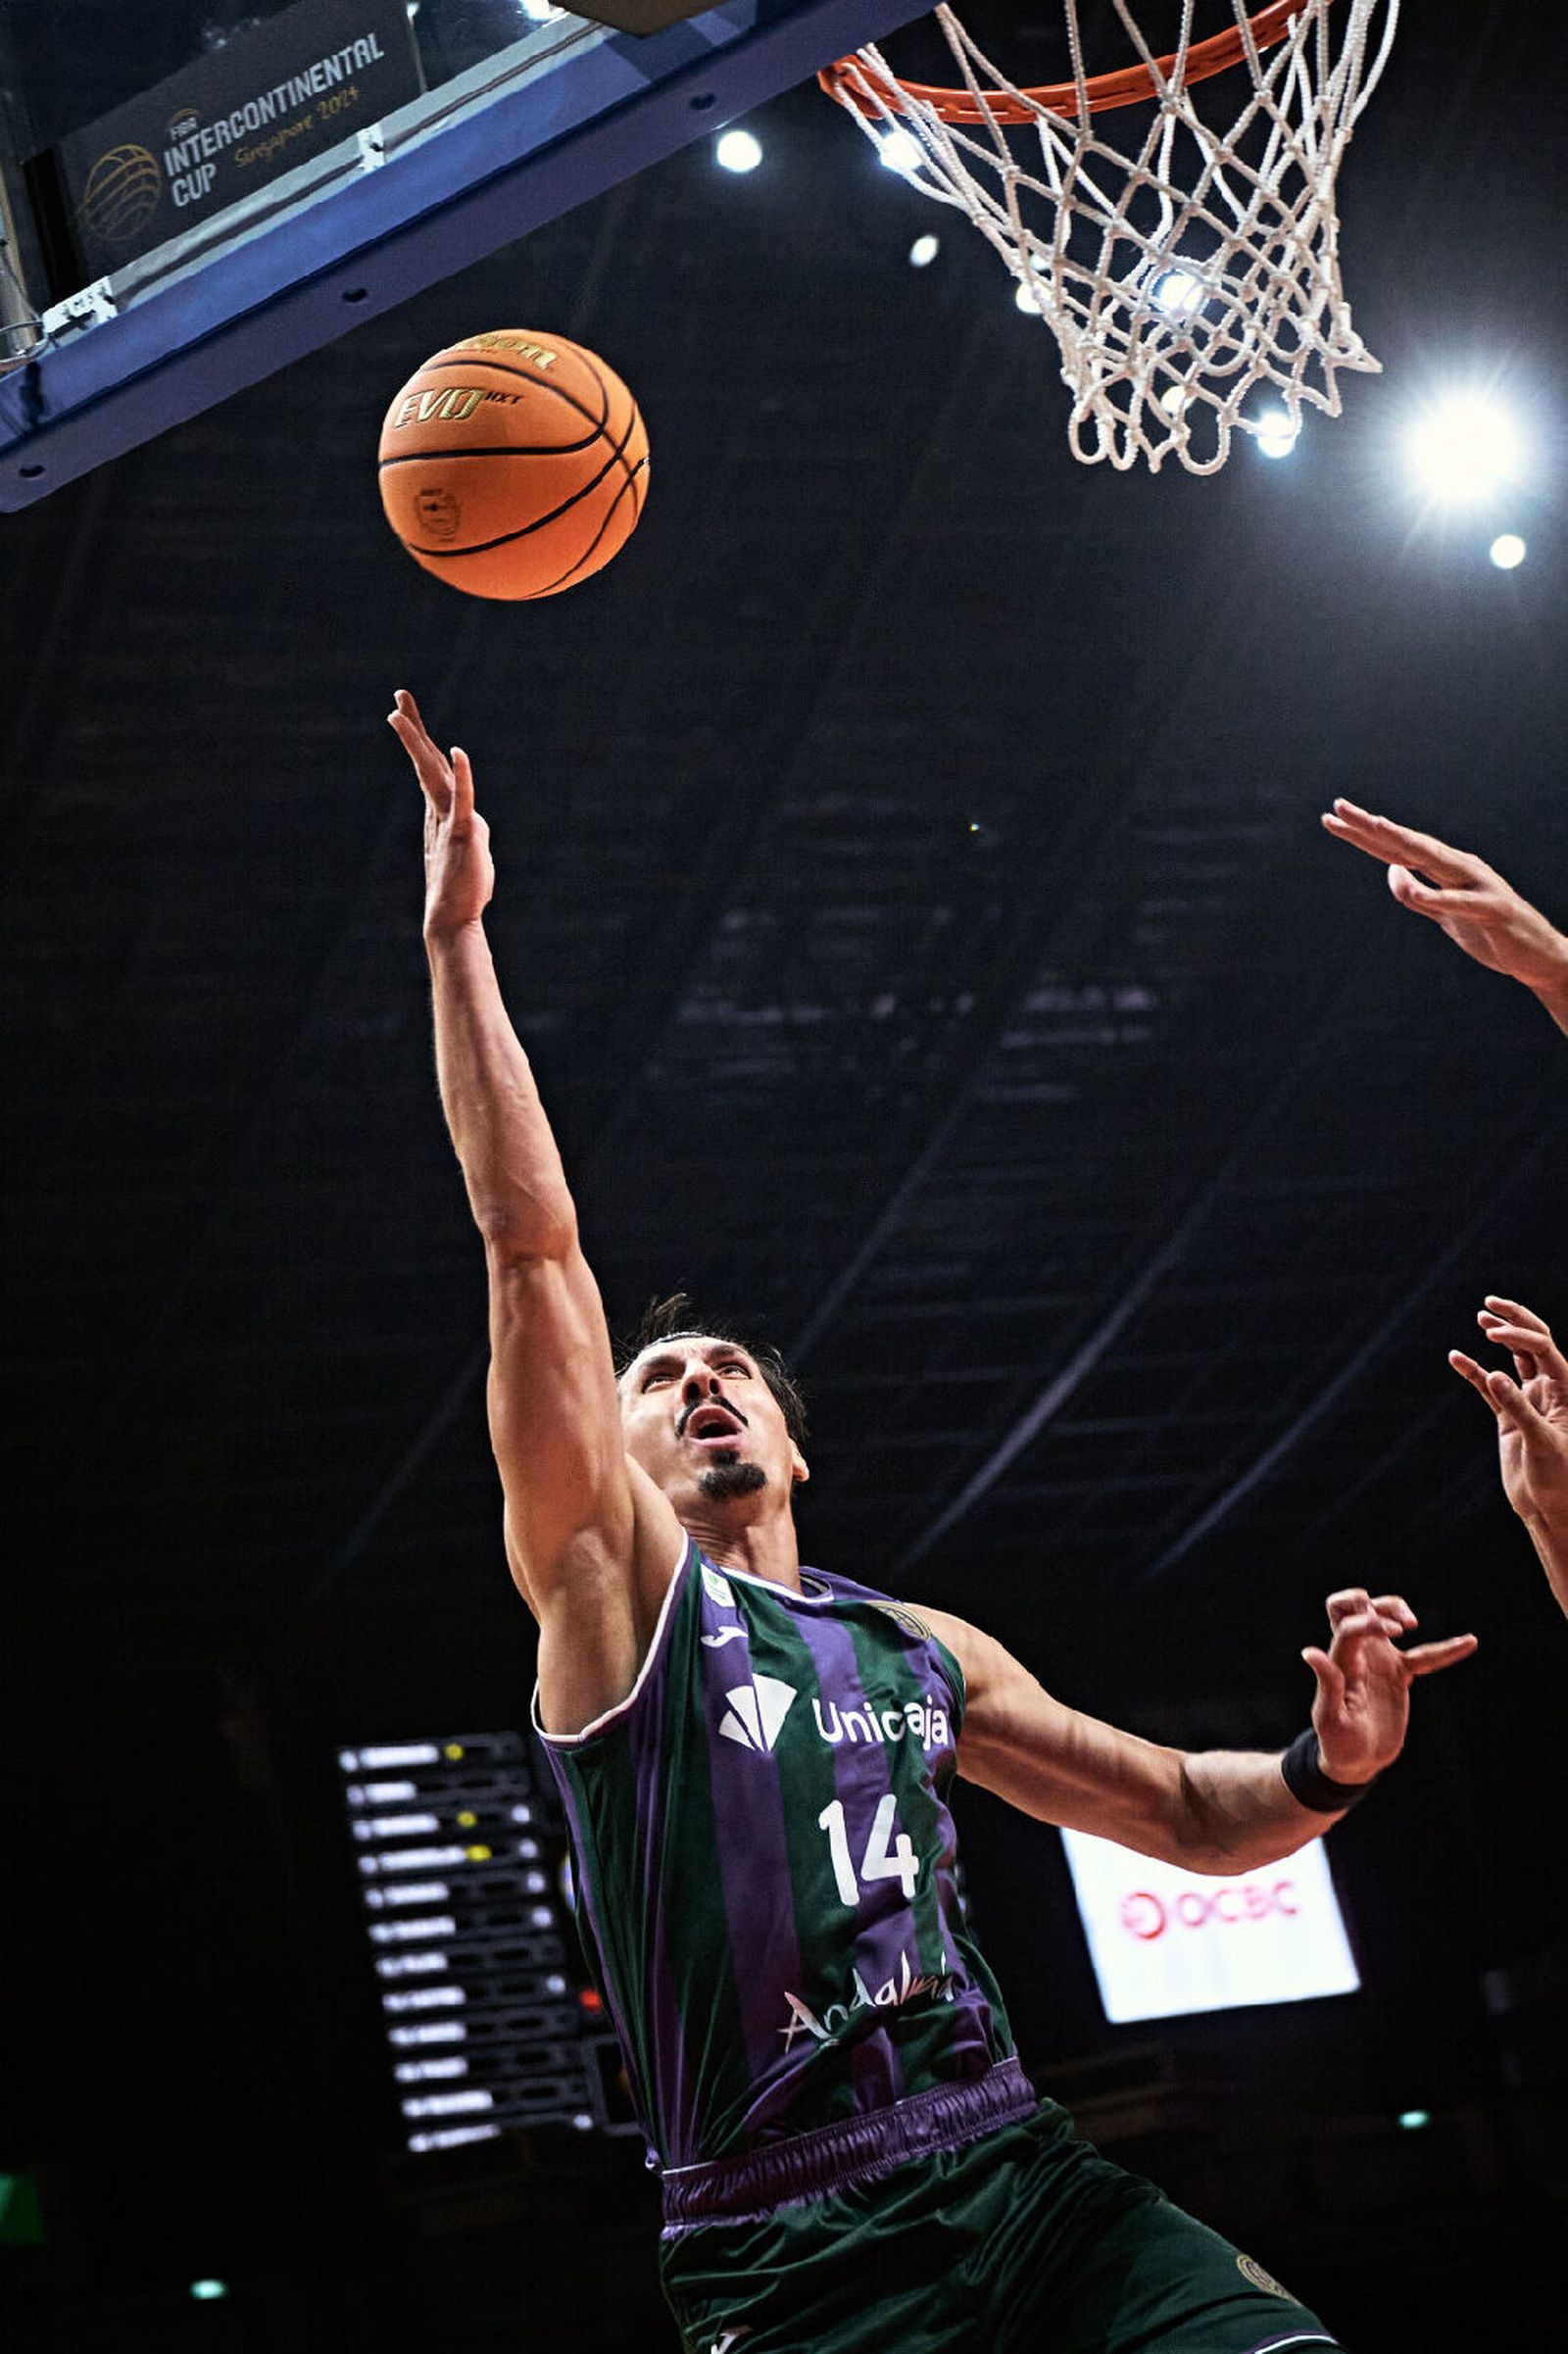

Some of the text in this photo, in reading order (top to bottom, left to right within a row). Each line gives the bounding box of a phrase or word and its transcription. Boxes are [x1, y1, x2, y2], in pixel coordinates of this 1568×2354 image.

[163, 32, 385, 177] INTERCONTINENTAL
[171, 163, 218, 208] CUP
[810, 1694, 950, 1752] Unicaja
[818, 1793, 919, 1906] 14
[1176, 1880, 1298, 1929] OCBC
